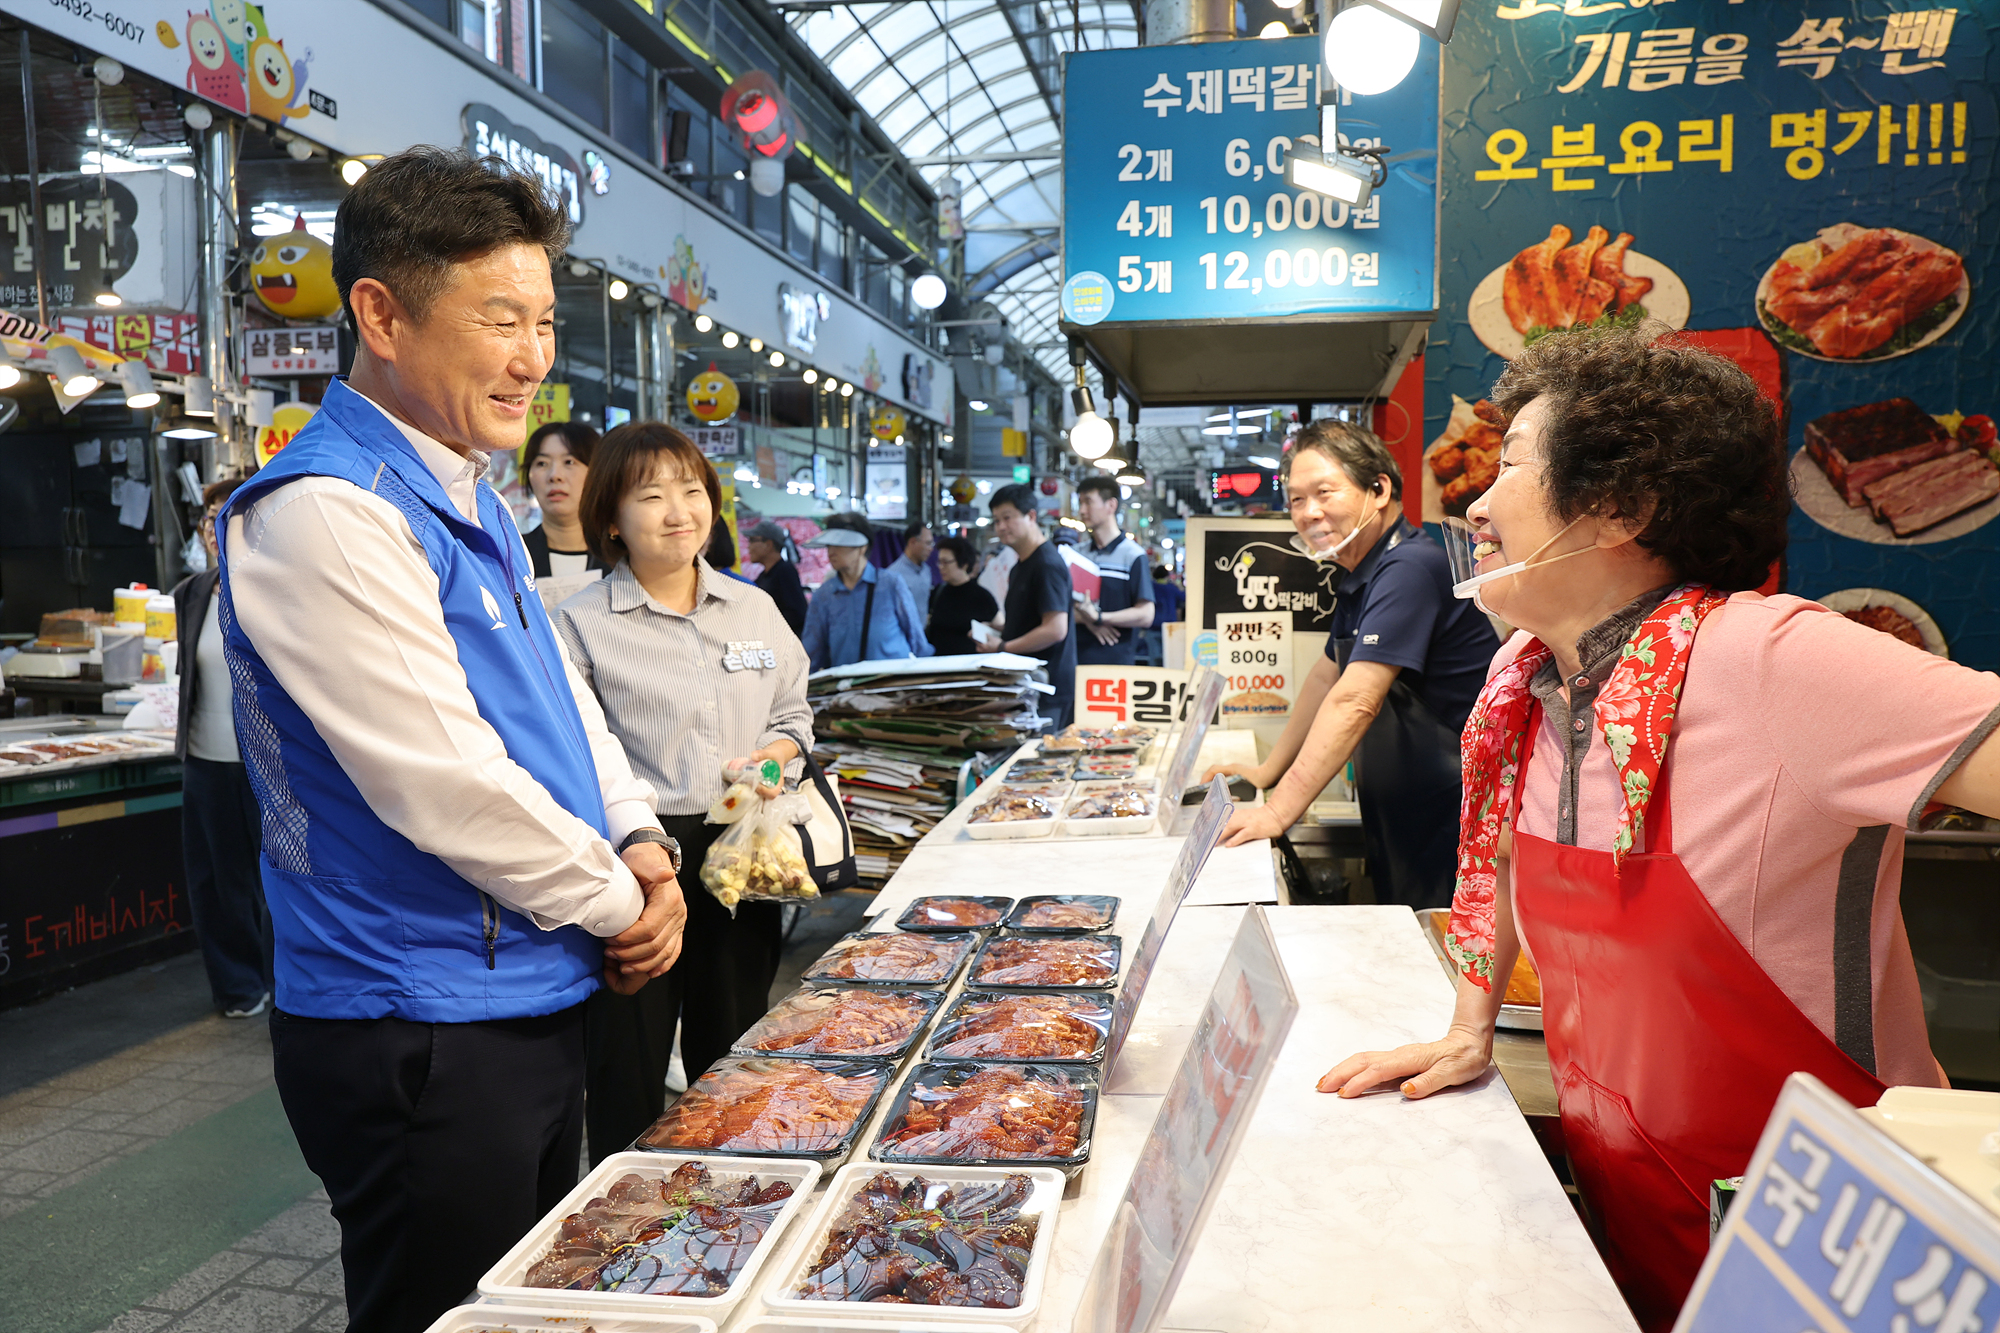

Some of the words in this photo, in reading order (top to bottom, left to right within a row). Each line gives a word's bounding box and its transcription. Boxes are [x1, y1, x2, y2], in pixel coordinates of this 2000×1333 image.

[1557, 28, 1749, 94] 기름을
[1776, 9, 1957, 80] 쏙~뺀
[1117, 143, 1173, 182] 2개
[1224, 132, 1382, 182] 6,0원
[1474, 114, 1734, 192] 오븐요리
[1770, 102, 1967, 181] 명가!!!
[1116, 200, 1173, 238] 4개
[1199, 190, 1380, 238] 10,000원
[1116, 254, 1173, 294] 5개
[1198, 246, 1380, 295] 12,000원
[1224, 621, 1284, 642] 생반죽
[724, 648, 777, 671] 손혜영
[1231, 649, 1278, 667] 800g
[1227, 674, 1285, 694] 10,000
[25, 882, 181, 958] 도깨비시장
